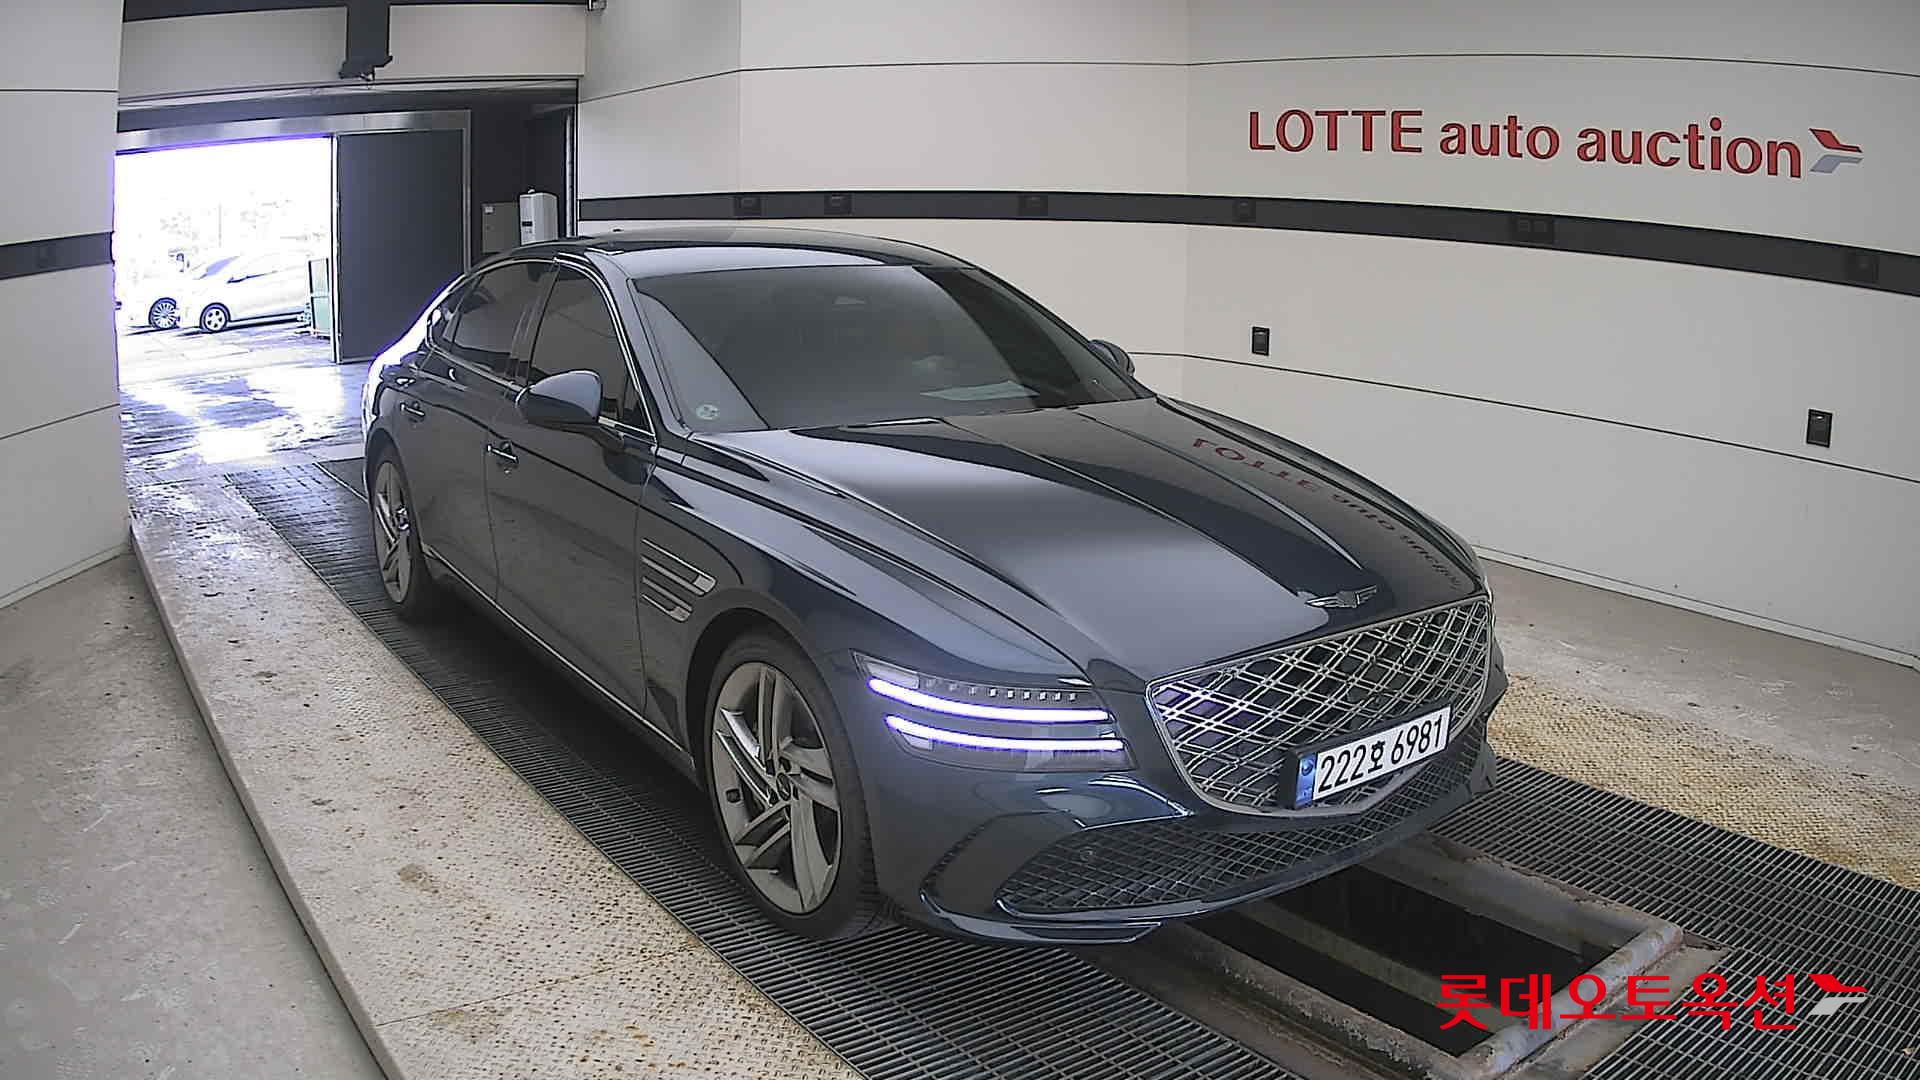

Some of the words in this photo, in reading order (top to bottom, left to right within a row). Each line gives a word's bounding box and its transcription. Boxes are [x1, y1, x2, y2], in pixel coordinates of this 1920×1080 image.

[1248, 109, 1424, 154] LOTTE
[1439, 115, 1561, 160] auto
[1576, 117, 1801, 179] auction
[1317, 740, 1386, 793] 222호
[1391, 714, 1443, 765] 6981
